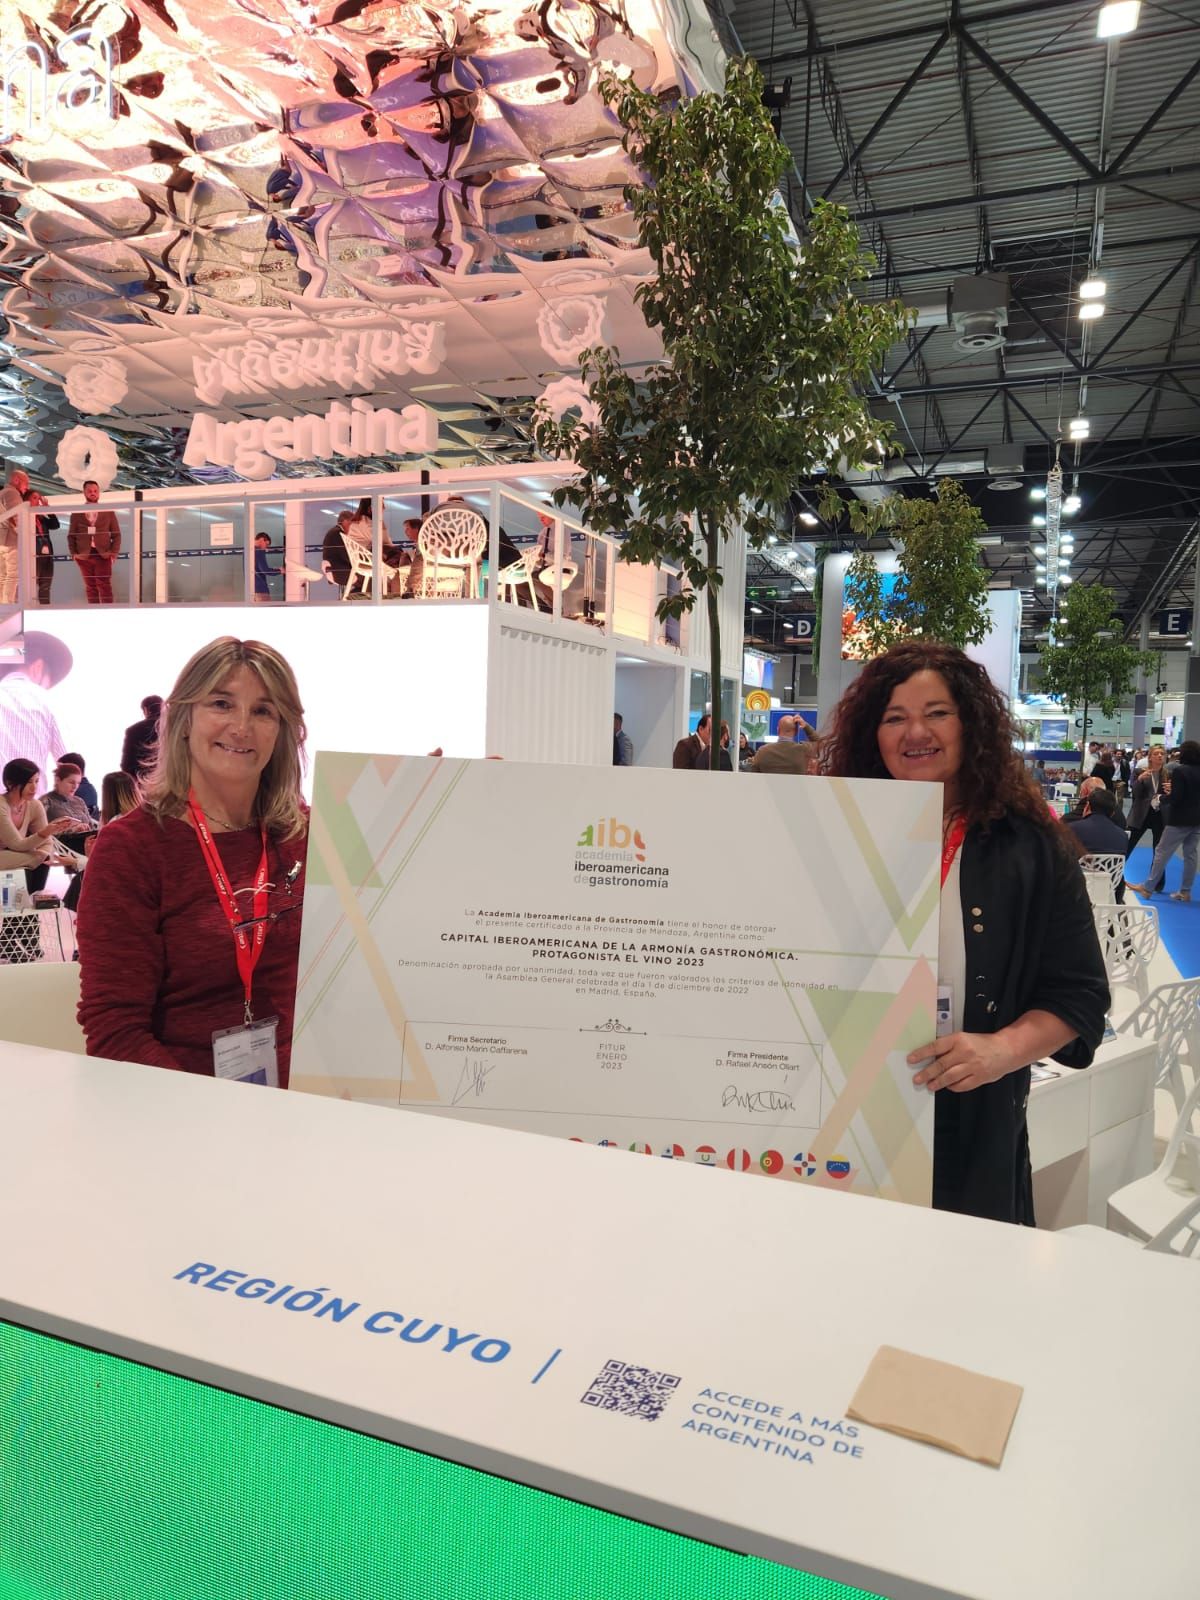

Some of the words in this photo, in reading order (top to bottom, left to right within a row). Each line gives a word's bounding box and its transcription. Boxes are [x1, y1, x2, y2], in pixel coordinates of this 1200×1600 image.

[182, 398, 439, 481] Argentina
[797, 620, 811, 636] D
[1168, 614, 1181, 631] E
[574, 850, 633, 861] academia
[574, 860, 669, 876] iberoamericana
[464, 908, 475, 917] La
[478, 909, 521, 919] Academia
[524, 910, 592, 922] Iberoamericana
[608, 917, 665, 927] Gastronomía
[667, 919, 689, 928] tiene
[691, 920, 700, 929] el
[702, 921, 727, 930] honor
[730, 923, 742, 931] de
[744, 924, 777, 934] otorgar
[475, 918, 483, 926] el
[485, 919, 524, 928] presente
[526, 921, 573, 931] certificado
[583, 924, 591, 932] la
[594, 924, 633, 935] Provincia
[636, 926, 647, 935] de
[693, 929, 736, 940] Argentina
[440, 932, 489, 944] CAPITAL
[493, 935, 598, 950] IBEROAMERICANA
[603, 941, 617, 950] DE
[622, 942, 637, 952] LA
[641, 942, 696, 955] ARMONÍA
[700, 946, 799, 961] GASTRONÓMICA.
[532, 949, 621, 962] PROTAGONISTA
[625, 954, 639, 963] EL
[643, 955, 672, 965] VINO
[676, 957, 704, 967] 2023
[398, 959, 460, 970] Denominación
[462, 962, 503, 973] aprobada
[505, 965, 521, 974] por
[578, 969, 599, 977] toda
[618, 971, 634, 981] que
[637, 971, 665, 981] fueron
[668, 973, 710, 983] valorados
[713, 976, 726, 984] los
[728, 977, 765, 986] criterios
[768, 979, 779, 987] de
[496, 973, 538, 983] Asamblea
[541, 975, 574, 985] General
[576, 977, 619, 987] celebrada
[621, 979, 629, 987] el
[632, 979, 645, 988] día
[654, 981, 665, 989] de
[668, 982, 711, 992] diciembre
[714, 985, 725, 993] de
[728, 986, 749, 995] 2022
[435, 1043, 464, 1052] Alfonso
[448, 1034, 468, 1043] Firma
[470, 1036, 507, 1045] Secretario
[599, 1043, 626, 1051] FITUR
[596, 1052, 628, 1061] ENERO
[726, 1059, 751, 1068] Rafael
[727, 1050, 748, 1059] Firma
[750, 1052, 789, 1061] Presidente
[600, 1061, 623, 1070] 2023
[172, 1261, 362, 1323] REGIÓN
[363, 1310, 512, 1364] CUYO
[698, 1387, 785, 1418] ACCEDE
[788, 1411, 804, 1424] A
[811, 1416, 861, 1439] MÁS
[691, 1402, 826, 1448] CONTENIDO
[832, 1440, 865, 1460] DE
[681, 1418, 815, 1465] ARGENTINA
